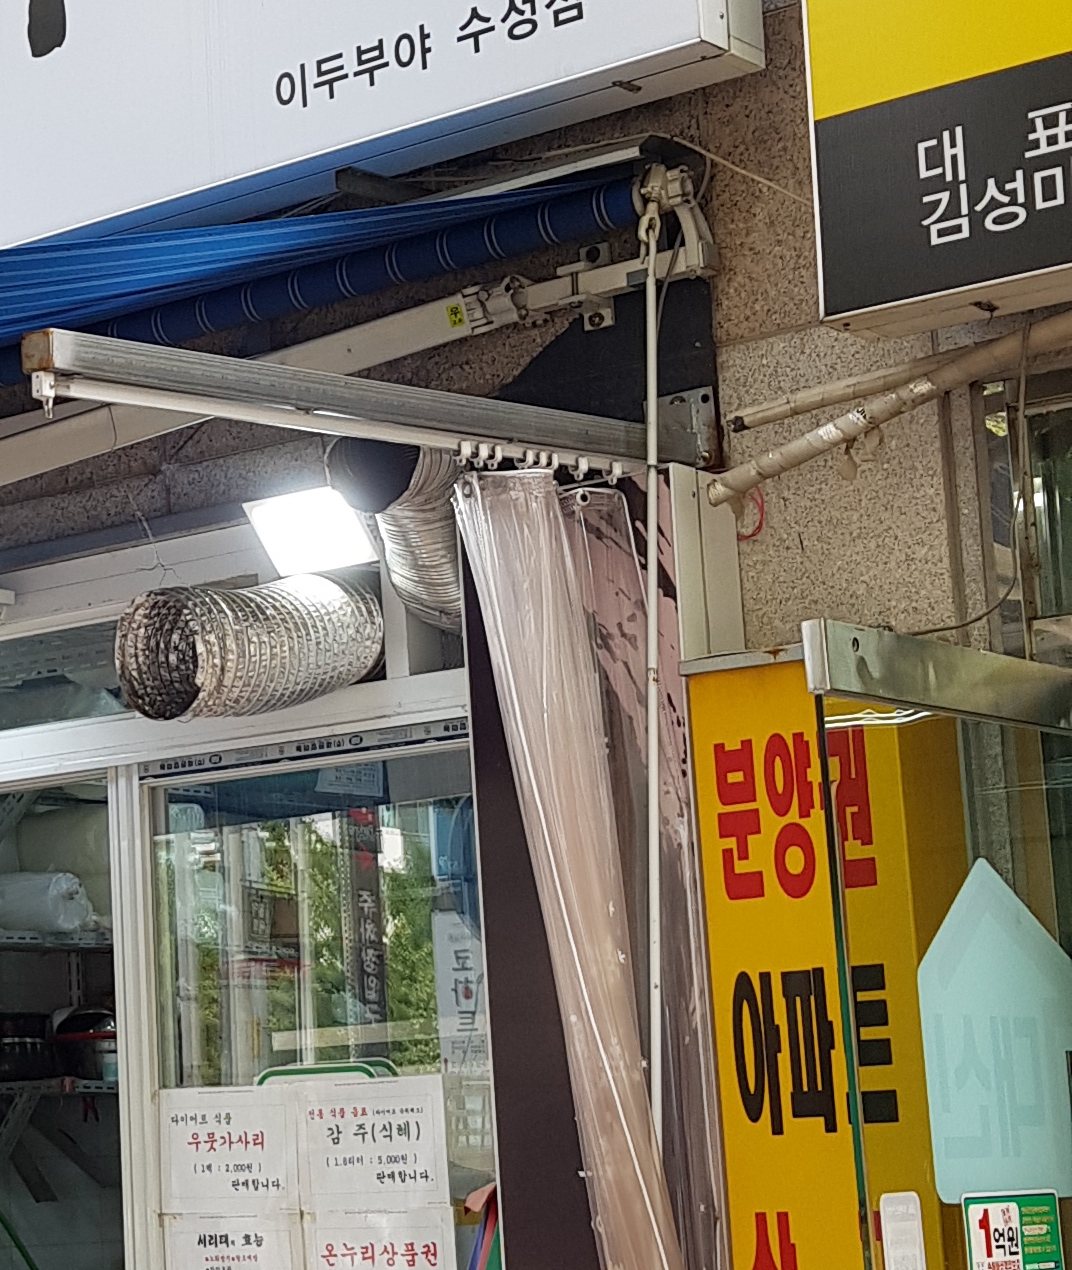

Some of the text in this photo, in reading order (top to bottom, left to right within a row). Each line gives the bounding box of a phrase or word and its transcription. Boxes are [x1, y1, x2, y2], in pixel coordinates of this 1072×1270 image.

[275, 23, 432, 108] 이두부야
[732, 960, 899, 1135] 아파트
[187, 1130, 265, 1153] 우뭇가사리
[320, 1241, 438, 1267] 온누리상품권
